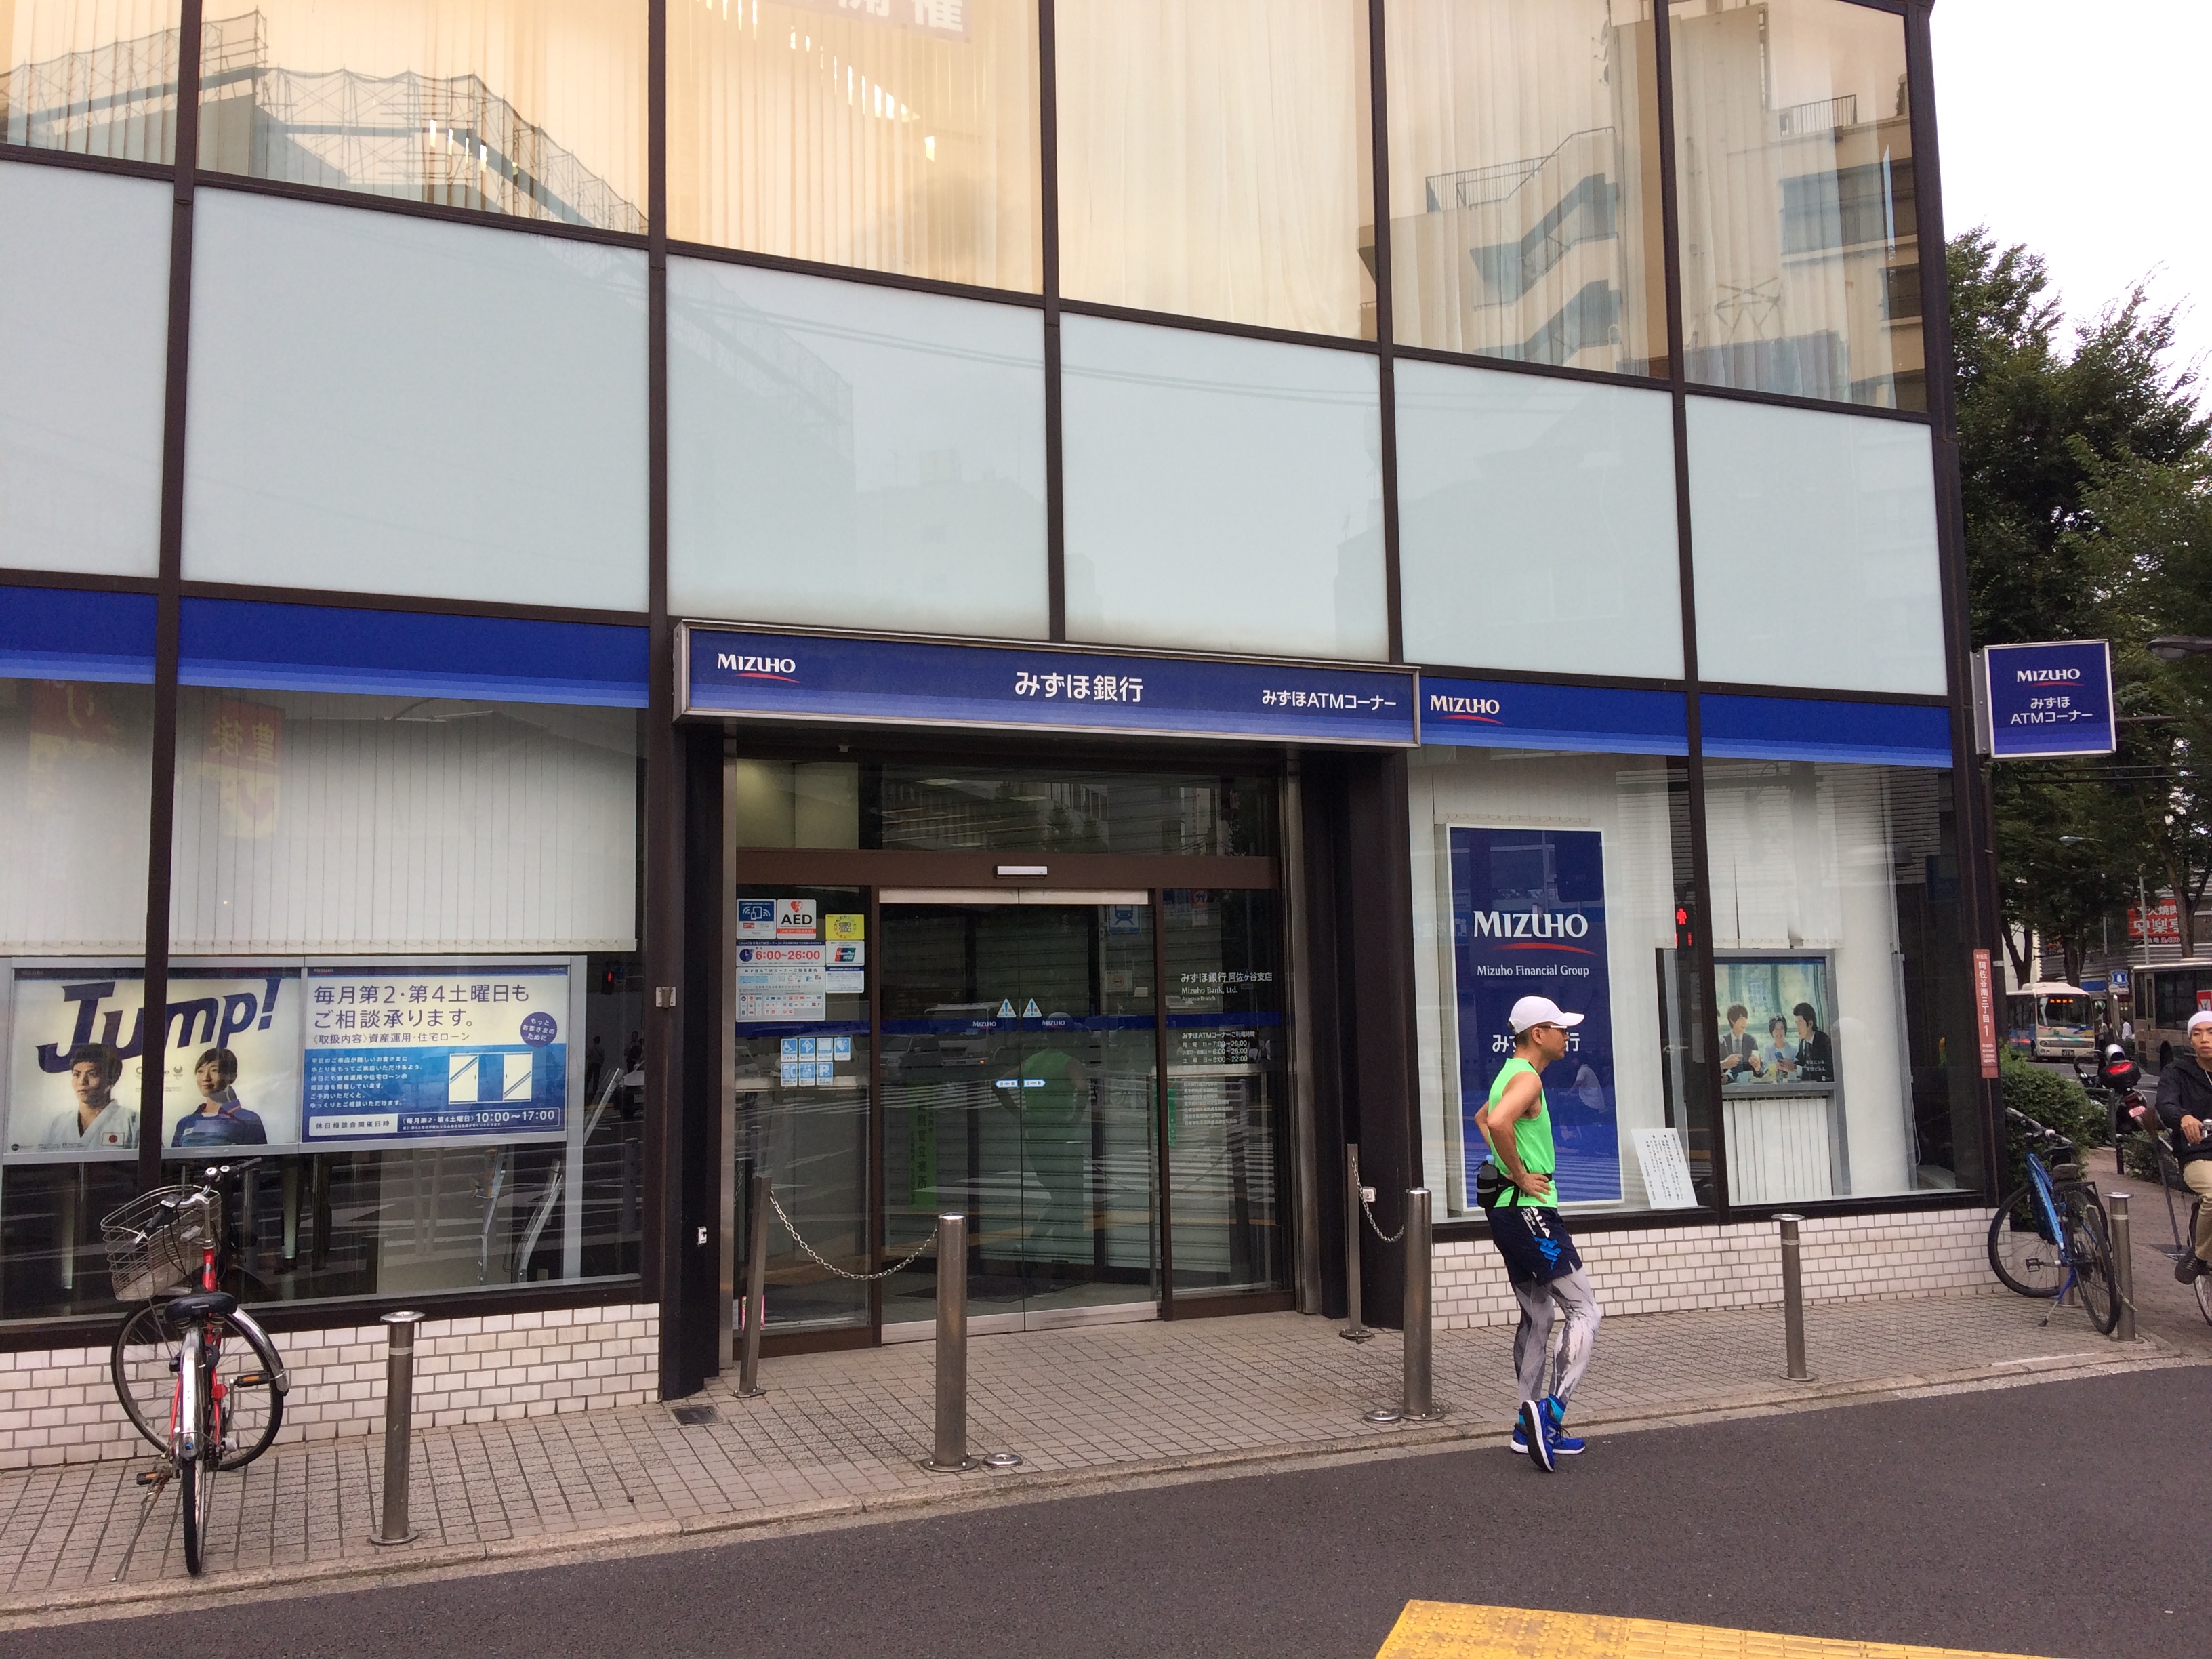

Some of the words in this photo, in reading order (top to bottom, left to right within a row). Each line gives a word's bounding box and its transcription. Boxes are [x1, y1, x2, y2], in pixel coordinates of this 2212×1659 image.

[717, 653, 796, 673] MIZUHO
[2017, 668, 2081, 682] MIZUHO
[1015, 672, 1143, 702] みずほ銀行
[1262, 690, 1397, 711] みずほATMコーナー
[1430, 695, 1500, 714] MIZUHO
[2030, 697, 2071, 709] みずほ
[2010, 710, 2093, 724] ATMコーナー
[781, 914, 813, 925] AED
[1473, 911, 1589, 938] MIZUHO
[1181, 972, 1227, 983] みずほ銀行
[1477, 965, 1513, 977] Mizuho
[1515, 965, 1557, 977] Financial
[1559, 965, 1590, 978] Group
[314, 984, 529, 1005] 毎月第2・第4土曜日も
[1207, 986, 1225, 994] Bank,
[314, 1008, 472, 1029] ご相談承ります。
[531, 1018, 550, 1026] もっと
[36, 979, 281, 1074] Jump!
[522, 1025, 555, 1034] お客さまの
[1984, 1025, 1989, 1037] 1
[527, 1033, 548, 1042] ために
[476, 1110, 555, 1123] 10:00～17:00
[316, 1120, 390, 1130] 休日相談会開催日時
[917, 1101, 928, 1189] 察官立寄所
